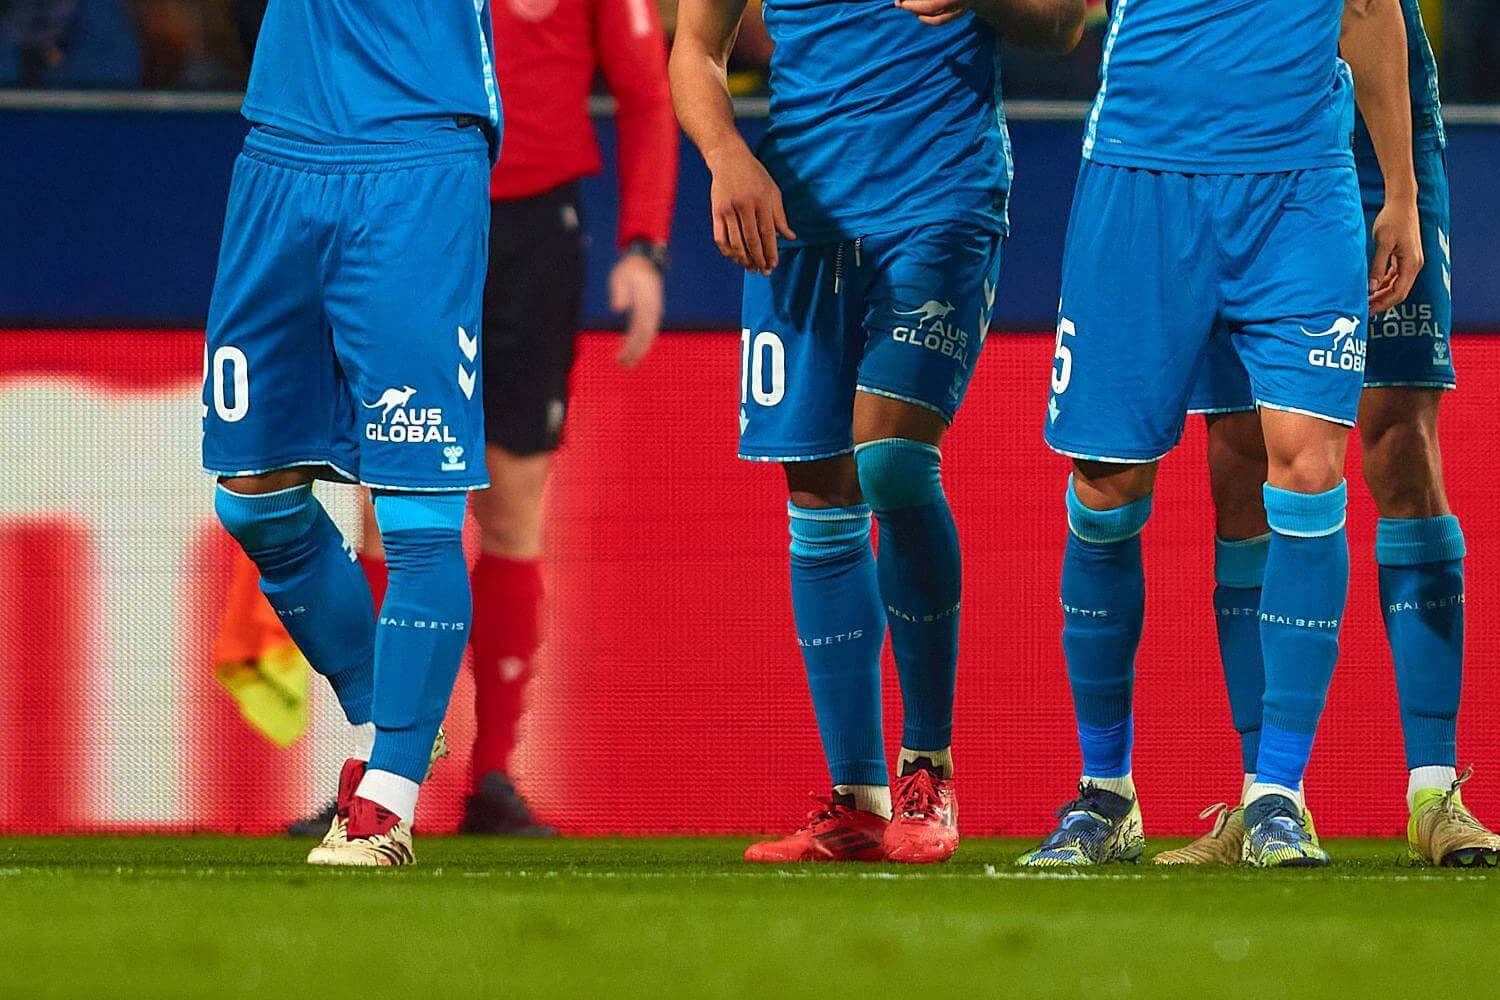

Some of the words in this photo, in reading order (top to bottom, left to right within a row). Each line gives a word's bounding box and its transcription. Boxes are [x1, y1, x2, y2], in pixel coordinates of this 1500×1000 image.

[1383, 304, 1432, 321] AUS
[929, 319, 969, 348] AUS
[1370, 321, 1443, 339] LOBAL
[893, 326, 969, 370] GLOBAL
[741, 327, 785, 407] 10
[391, 407, 442, 426] AUS
[366, 423, 457, 443] GLOBAL
[414, 620, 466, 632] BETIS
[1260, 613, 1292, 626] REAL
[1295, 618, 1339, 629] BETIS
[812, 628, 864, 647] BETIS
